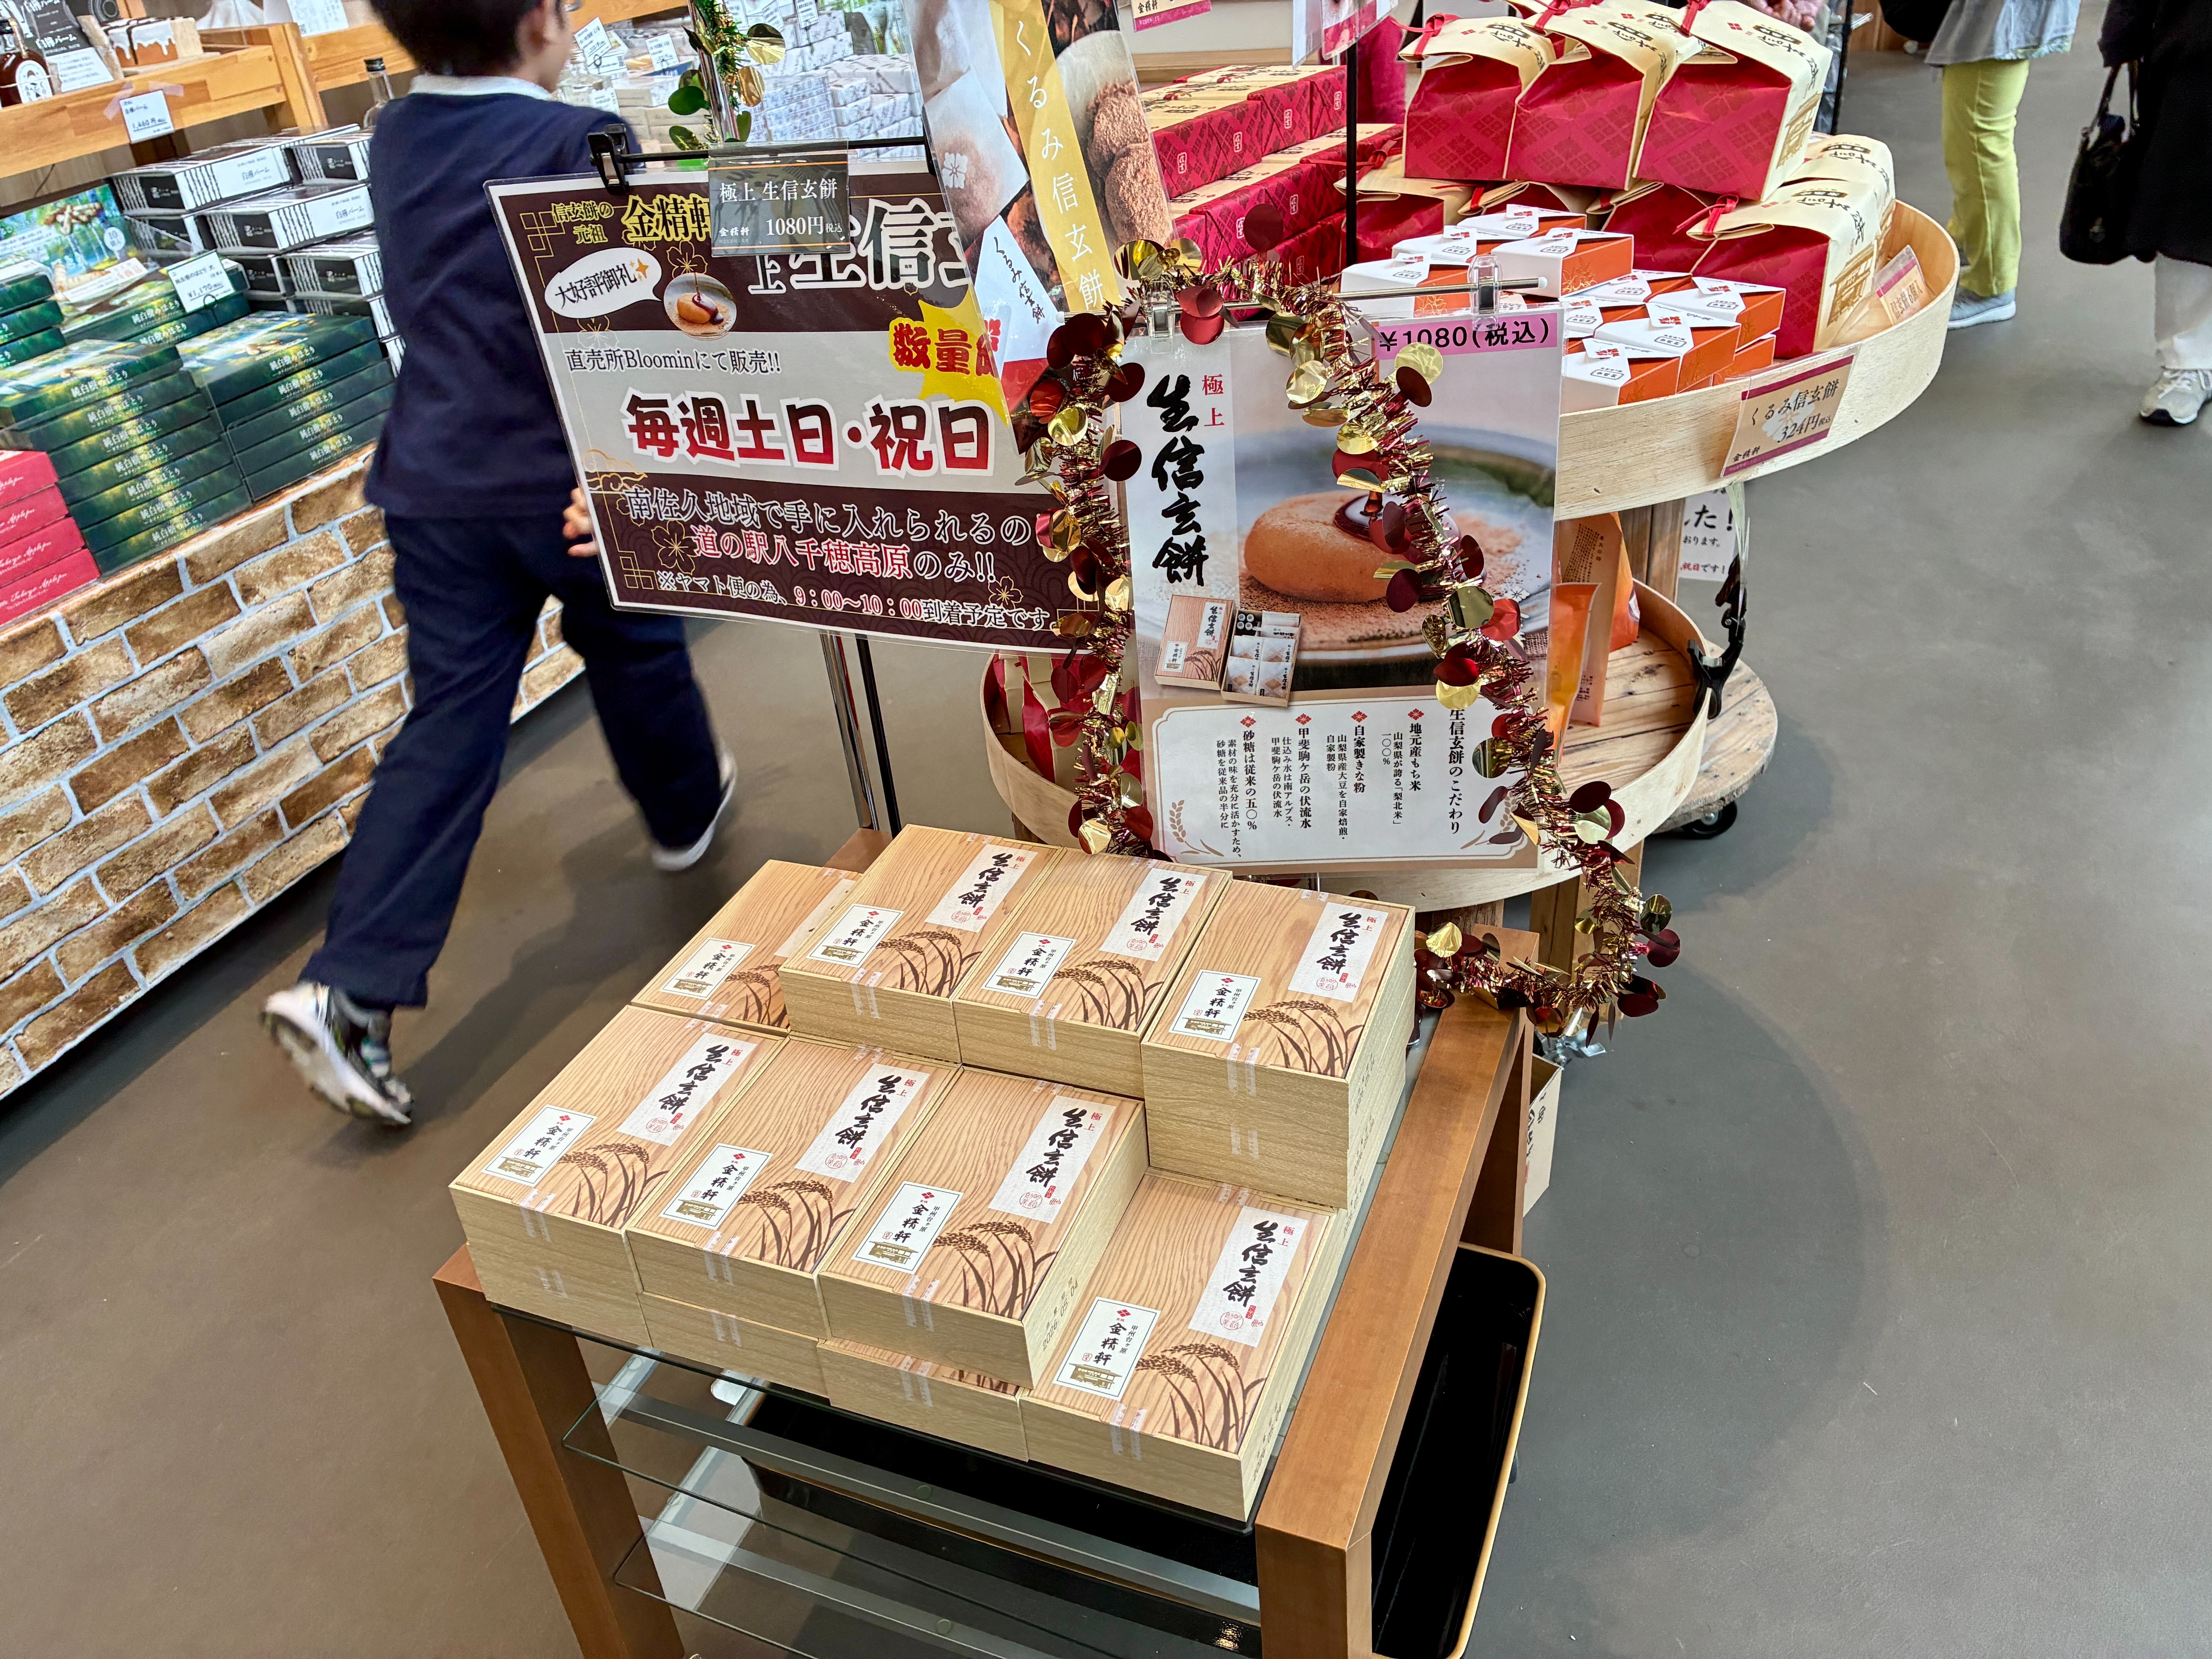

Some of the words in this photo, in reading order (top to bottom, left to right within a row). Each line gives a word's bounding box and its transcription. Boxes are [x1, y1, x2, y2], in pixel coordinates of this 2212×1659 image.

[1016, 20, 1104, 311] くるみ信玄餅
[551, 201, 614, 223] 信玄餅の
[719, 182, 756, 203] 極上
[762, 178, 838, 201] 生信玄餅
[573, 225, 608, 244] 元祖
[719, 227, 750, 237] 金精軒
[766, 216, 824, 236] 1080円
[826, 223, 843, 233] 税込
[555, 262, 638, 309] 大好評御礼
[994, 236, 1045, 324] くるみ信玄餅
[1202, 373, 1224, 428] 極上
[1752, 378, 1839, 426] くるみ信玄餅
[627, 392, 990, 474] 毎週土日・祝日
[1777, 413, 1821, 443] 324円
[1733, 445, 1760, 462] 金精軒
[1147, 373, 1209, 587] 生信玄餅
[624, 488, 1042, 547] 南佐久地域で手に入れられるの
[692, 525, 996, 583] 道の駅八千穂高原のみ!!
[1326, 735, 1336, 771] 自家製粉
[1353, 725, 1366, 793] 自家製きな粉
[1409, 723, 1422, 791] 地元産もち米
[1448, 709, 1465, 834] 生信玄餅のこだわり
[1216, 740, 1229, 829] 砂糖を従来品の半分に
[1228, 739, 1242, 857] 素材の味を充分に活かすため、
[1282, 737, 1293, 826] 仕込み水は南アルプス・
[1338, 734, 1348, 840] 山梨県産大豆を自家焙煎・
[1393, 732, 1403, 824] 山梨県が誇る「梨北米」
[958, 852, 1013, 908] 生信玄餅
[1009, 855, 1027, 870] 極上
[1131, 877, 1182, 936] 生信玄餅
[1180, 880, 1197, 895] 極上
[842, 919, 874, 946] 金精軒
[1317, 912, 1362, 974] 生信玄餅
[1362, 915, 1378, 932] 極上
[694, 952, 726, 980] 金精軒
[1017, 947, 1047, 976] 金精軒
[1204, 986, 1232, 1018] 金精軒
[659, 1044, 730, 1115] 生信玄餅
[722, 1048, 743, 1066] 極上
[896, 1079, 917, 1097] 極上
[835, 1075, 902, 1149] 生信玄餅
[1084, 1112, 1103, 1131] 極上
[524, 1125, 563, 1159] 金精軒
[1025, 1108, 1087, 1188] 生信玄餅
[701, 1164, 738, 1201] 金精軒
[893, 1204, 929, 1243] 金精軒
[1277, 1225, 1296, 1247] 極上
[1223, 1220, 1278, 1307] 生信玄餅
[1093, 1322, 1127, 1366] 金精軒
